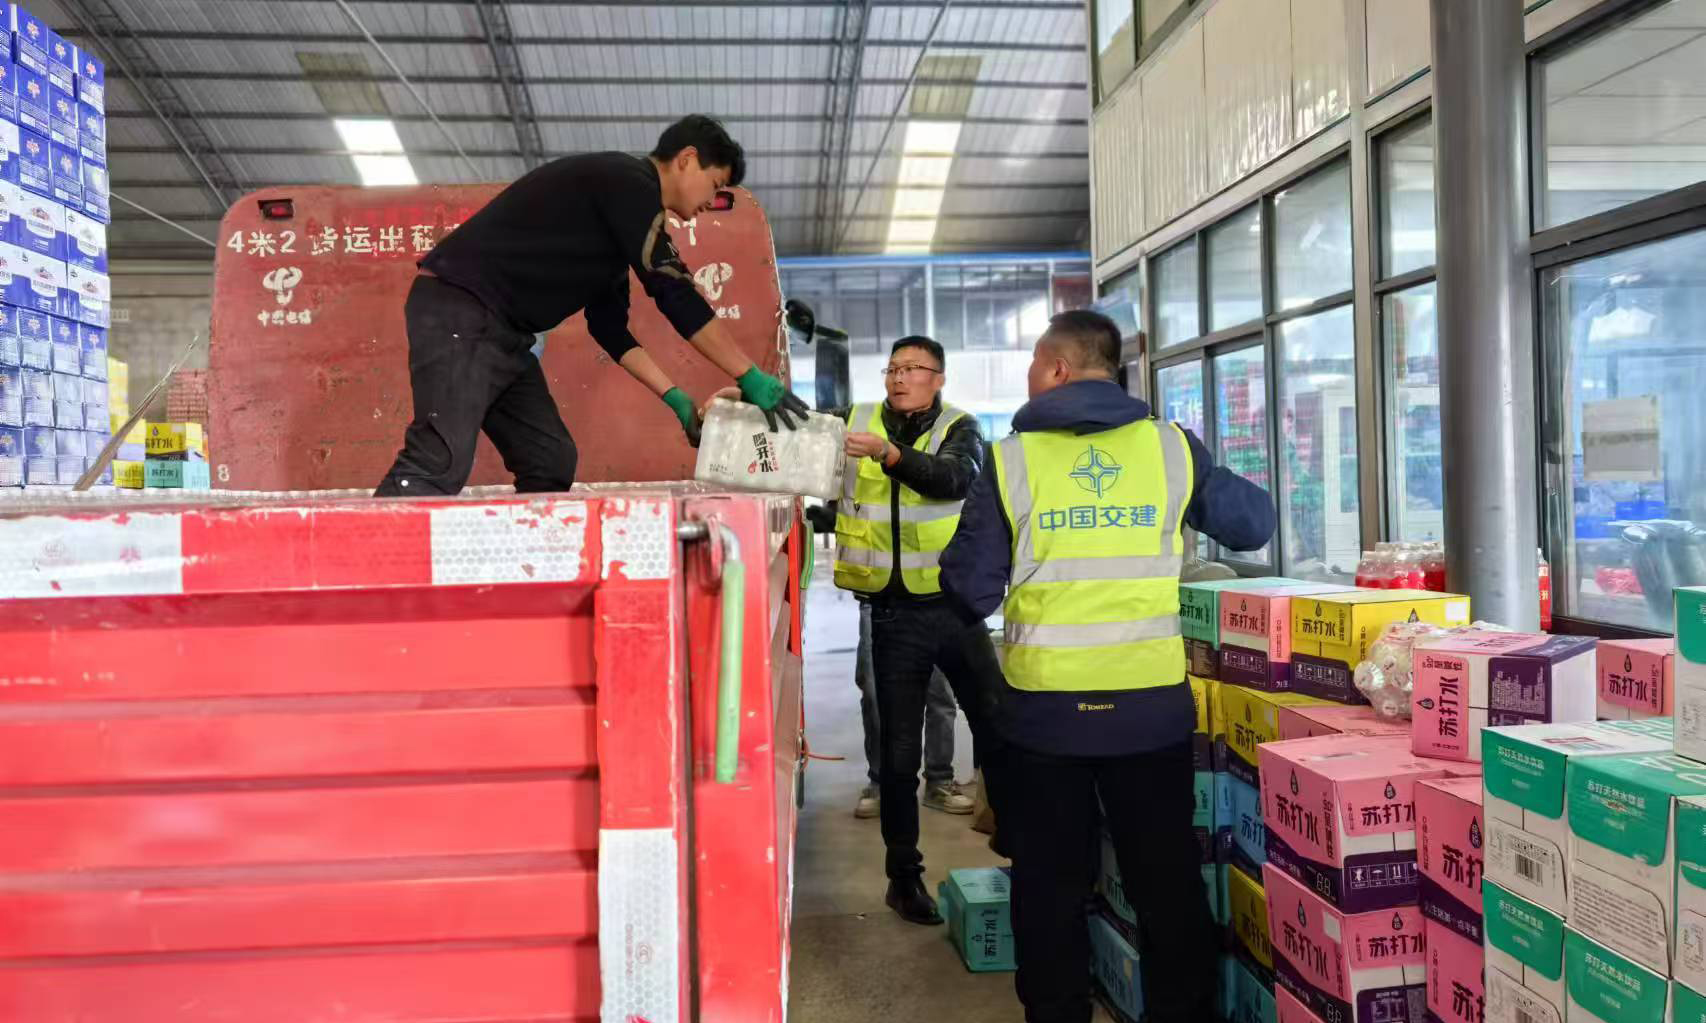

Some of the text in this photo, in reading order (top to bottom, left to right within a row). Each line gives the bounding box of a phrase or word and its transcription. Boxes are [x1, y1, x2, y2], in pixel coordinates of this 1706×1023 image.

[226, 223, 461, 257] 4米2 货运出租
[217, 463, 230, 482] 8
[1039, 504, 1158, 531] 中国交建
[1229, 613, 1259, 632] 苏打水
[1302, 618, 1336, 637] 苏打水
[1608, 673, 1648, 703] 苏打水
[1439, 676, 1459, 737] 苏打水
[1241, 812, 1264, 847] 苏打
[1275, 793, 1321, 847] 苏打水
[1442, 844, 1483, 895] 苏打
[1282, 920, 1330, 981] 苏打水
